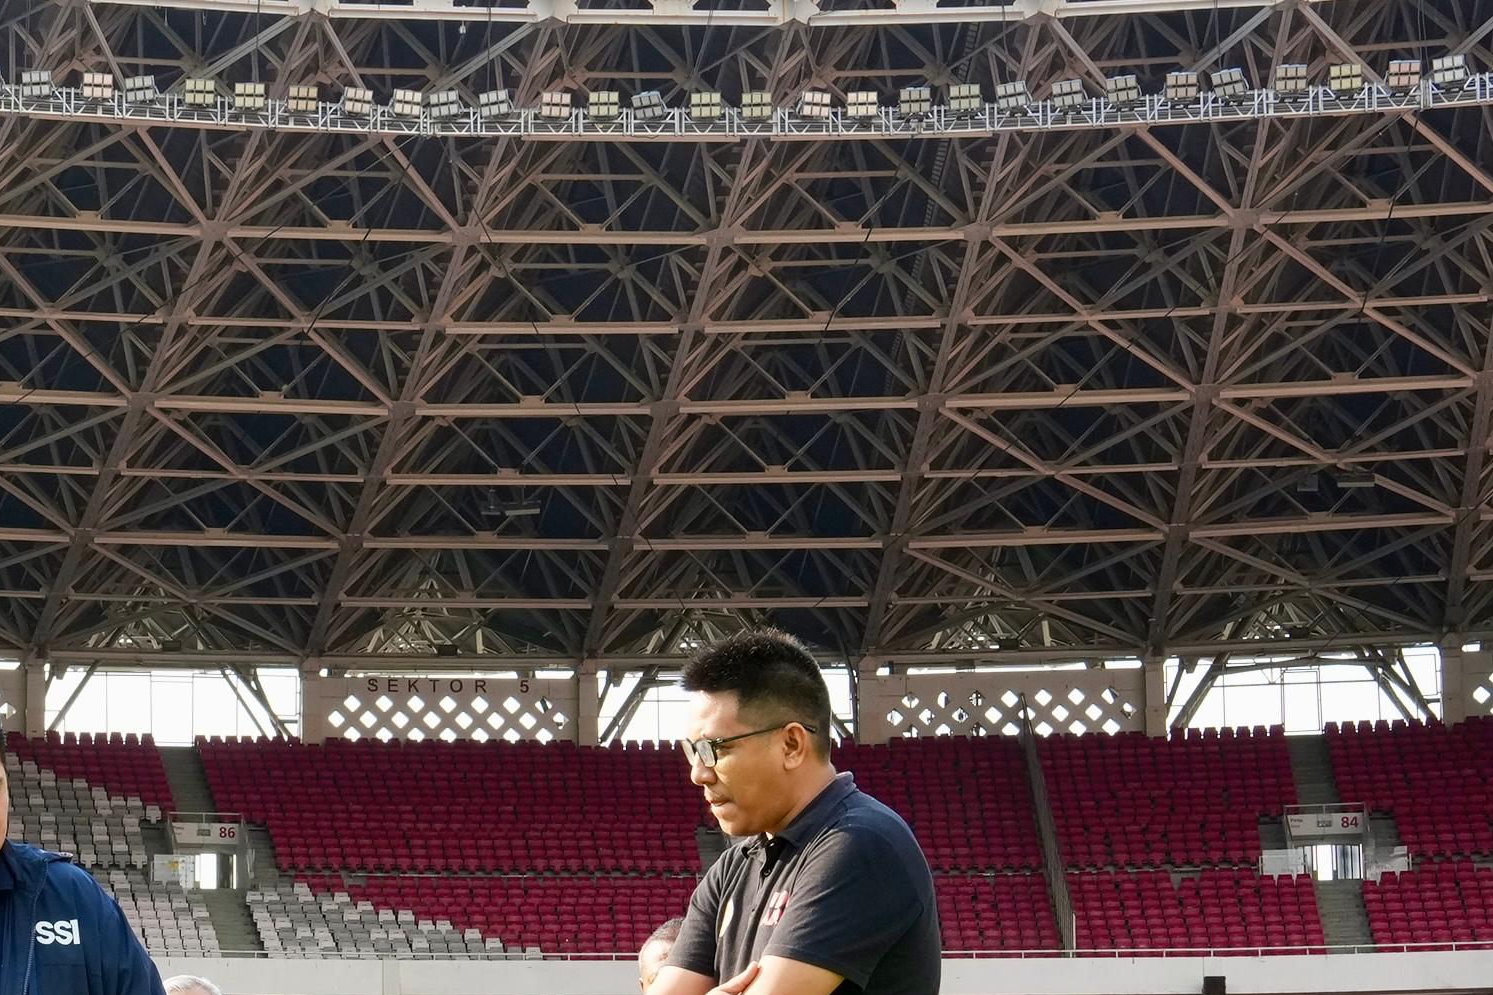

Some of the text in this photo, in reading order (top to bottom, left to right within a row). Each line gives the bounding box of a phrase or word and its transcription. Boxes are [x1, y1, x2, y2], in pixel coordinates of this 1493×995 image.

[367, 678, 530, 694] SEKTOR 5
[1340, 816, 1359, 828] 84
[219, 826, 236, 839] 86
[35, 918, 81, 946] SSI
